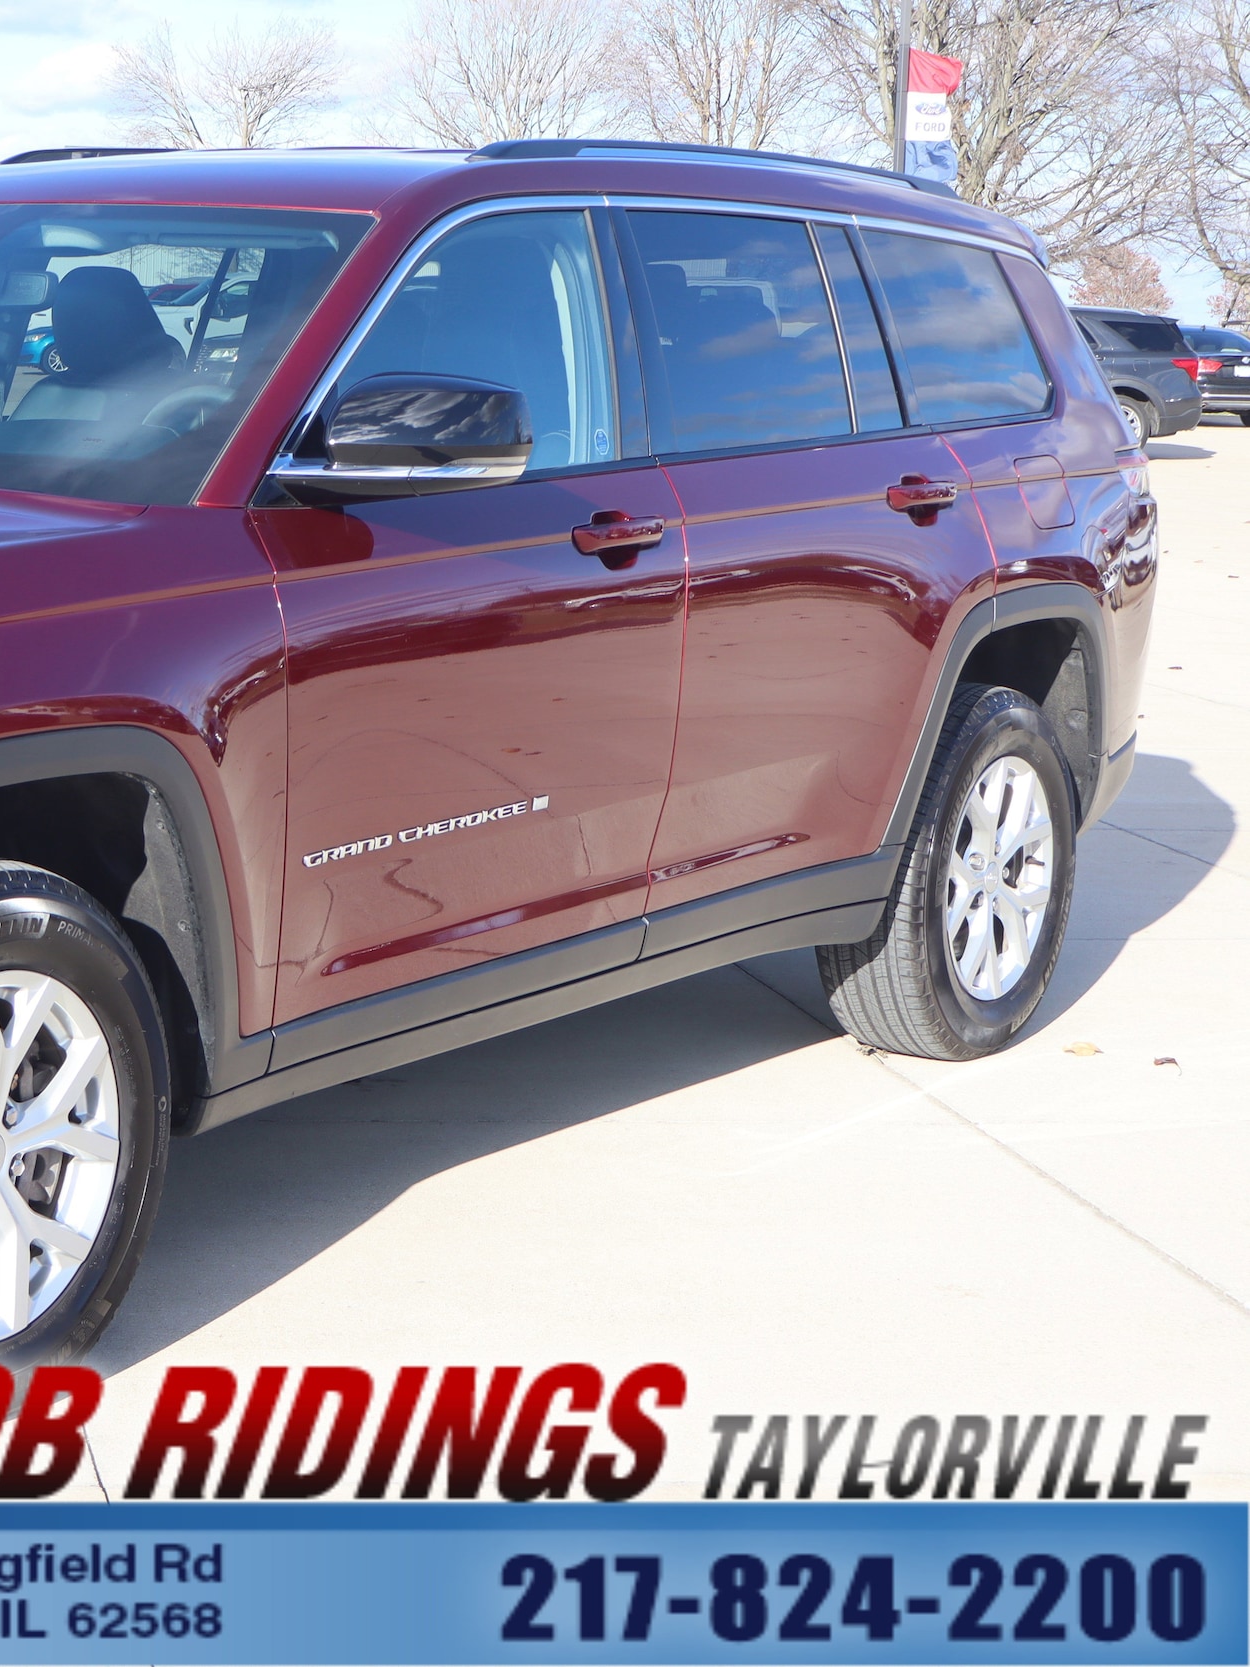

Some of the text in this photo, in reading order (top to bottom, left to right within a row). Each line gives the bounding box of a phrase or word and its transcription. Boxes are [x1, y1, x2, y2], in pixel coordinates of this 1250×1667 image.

[915, 122, 945, 132] FORD
[303, 801, 528, 868] GRAND CHEROKEE
